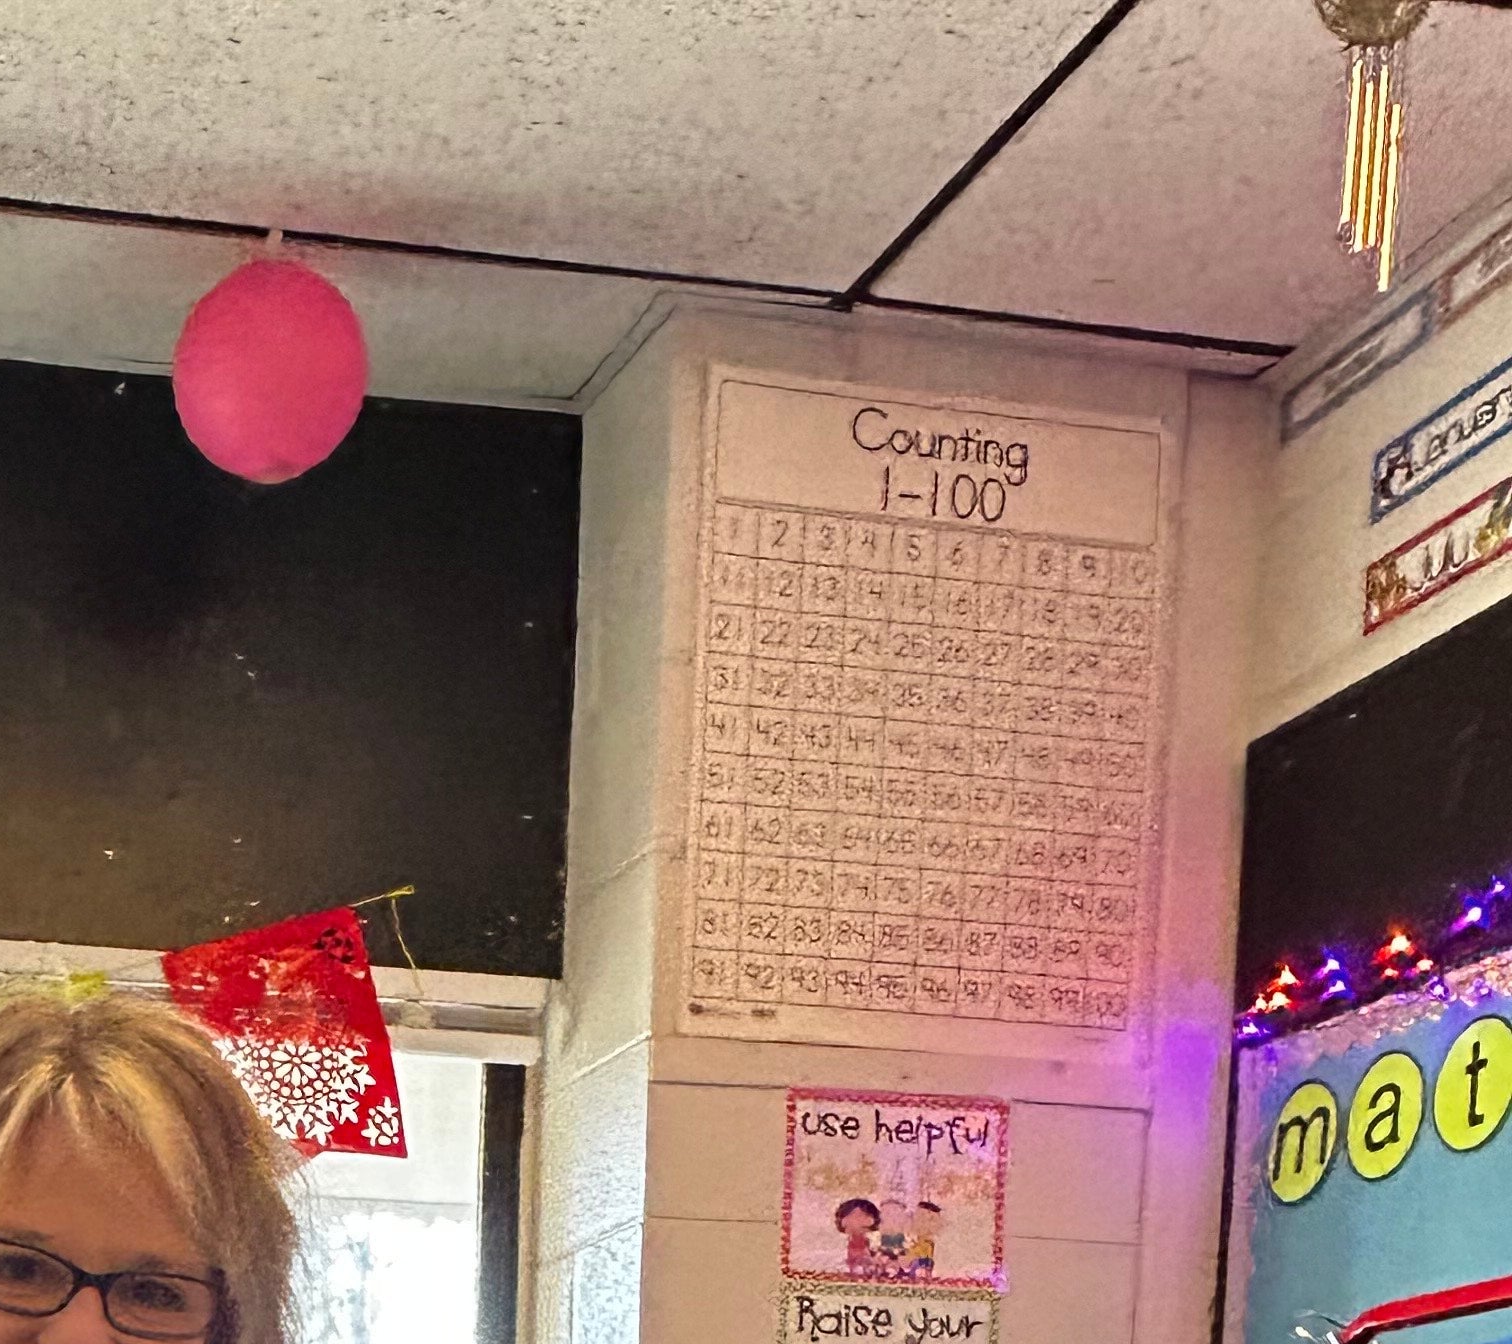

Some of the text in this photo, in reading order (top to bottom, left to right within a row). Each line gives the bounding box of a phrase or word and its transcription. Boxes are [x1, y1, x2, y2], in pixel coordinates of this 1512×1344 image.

[852, 407, 1029, 486] Counting
[881, 466, 1006, 522] 1-100
[801, 1108, 990, 1154] use helpful
[1273, 1041, 1489, 1181] mat
[795, 1294, 893, 1343] Raise
